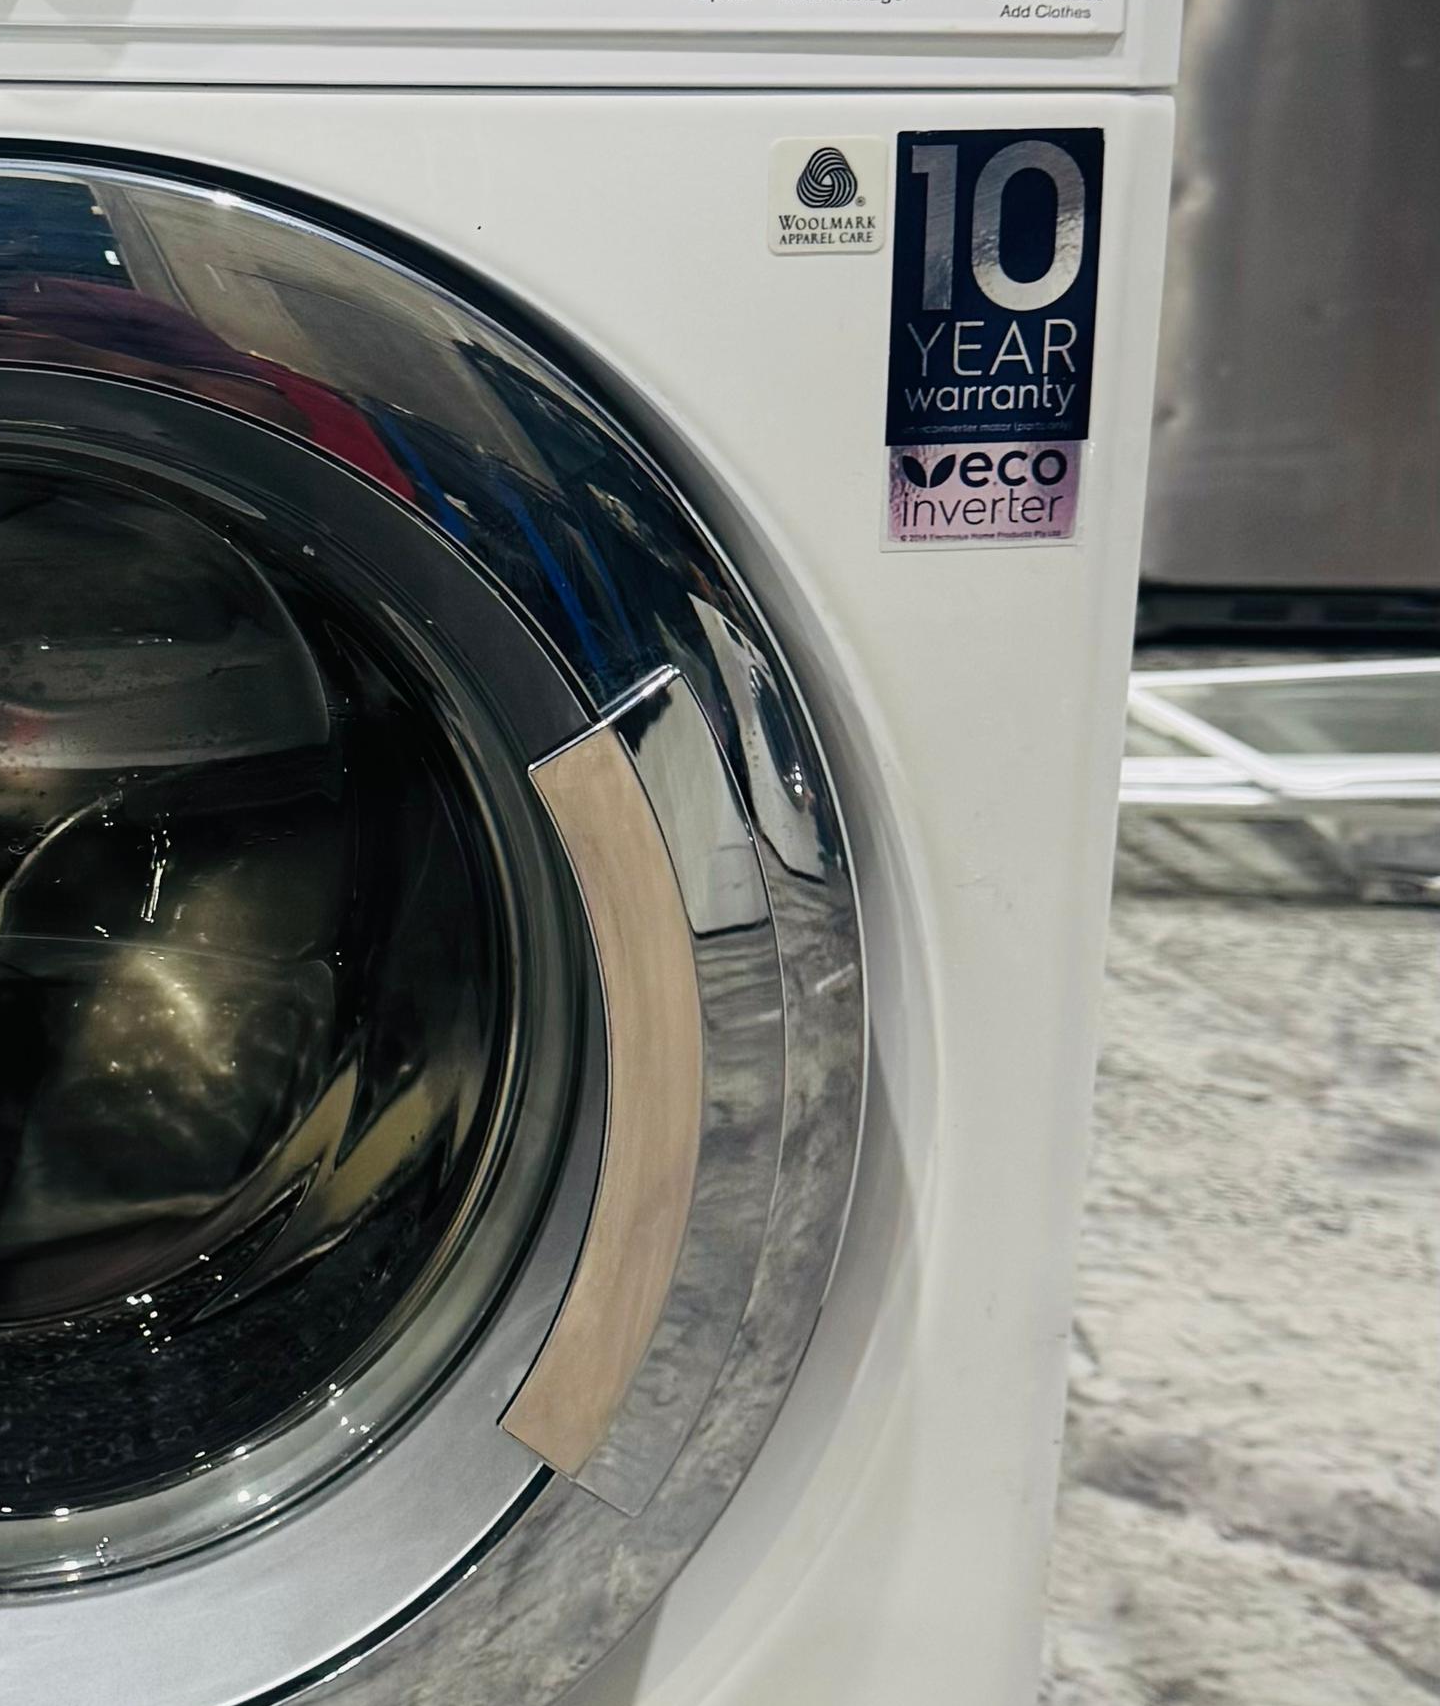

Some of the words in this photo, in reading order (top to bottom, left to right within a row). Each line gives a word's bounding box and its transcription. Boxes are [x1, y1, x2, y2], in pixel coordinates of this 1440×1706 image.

[1000, 4, 1031, 19] Add
[1034, 4, 1092, 19] Clothes
[778, 214, 876, 231] WOOLMARK
[779, 232, 835, 245] APPAREL
[839, 231, 873, 244] CARE
[911, 139, 1086, 312] 10
[906, 318, 1077, 378] YEAR
[904, 376, 1077, 417] warranty
[959, 448, 1068, 488] eco
[902, 488, 1064, 527] inverter
